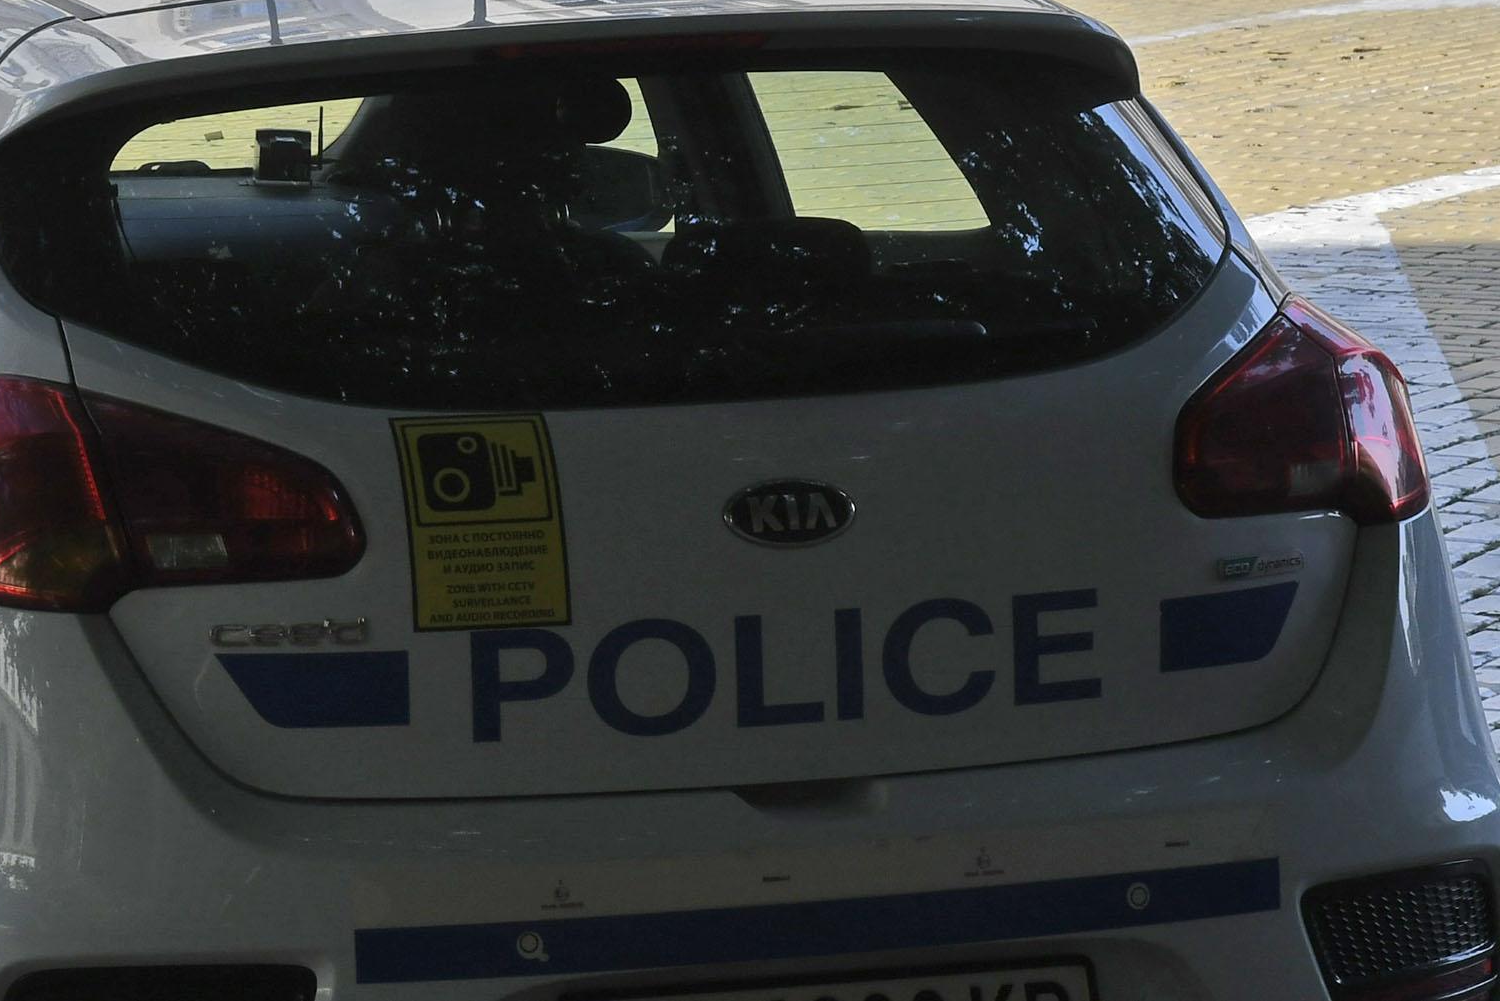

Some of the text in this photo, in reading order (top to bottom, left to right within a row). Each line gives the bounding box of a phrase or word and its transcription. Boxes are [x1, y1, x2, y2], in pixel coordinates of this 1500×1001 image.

[745, 492, 837, 533] KIA
[428, 534, 460, 545] ЗОНА
[454, 562, 494, 575] АУДИО
[446, 581, 536, 595] ZONE WITH CCTV
[470, 588, 1103, 743] POLICE
